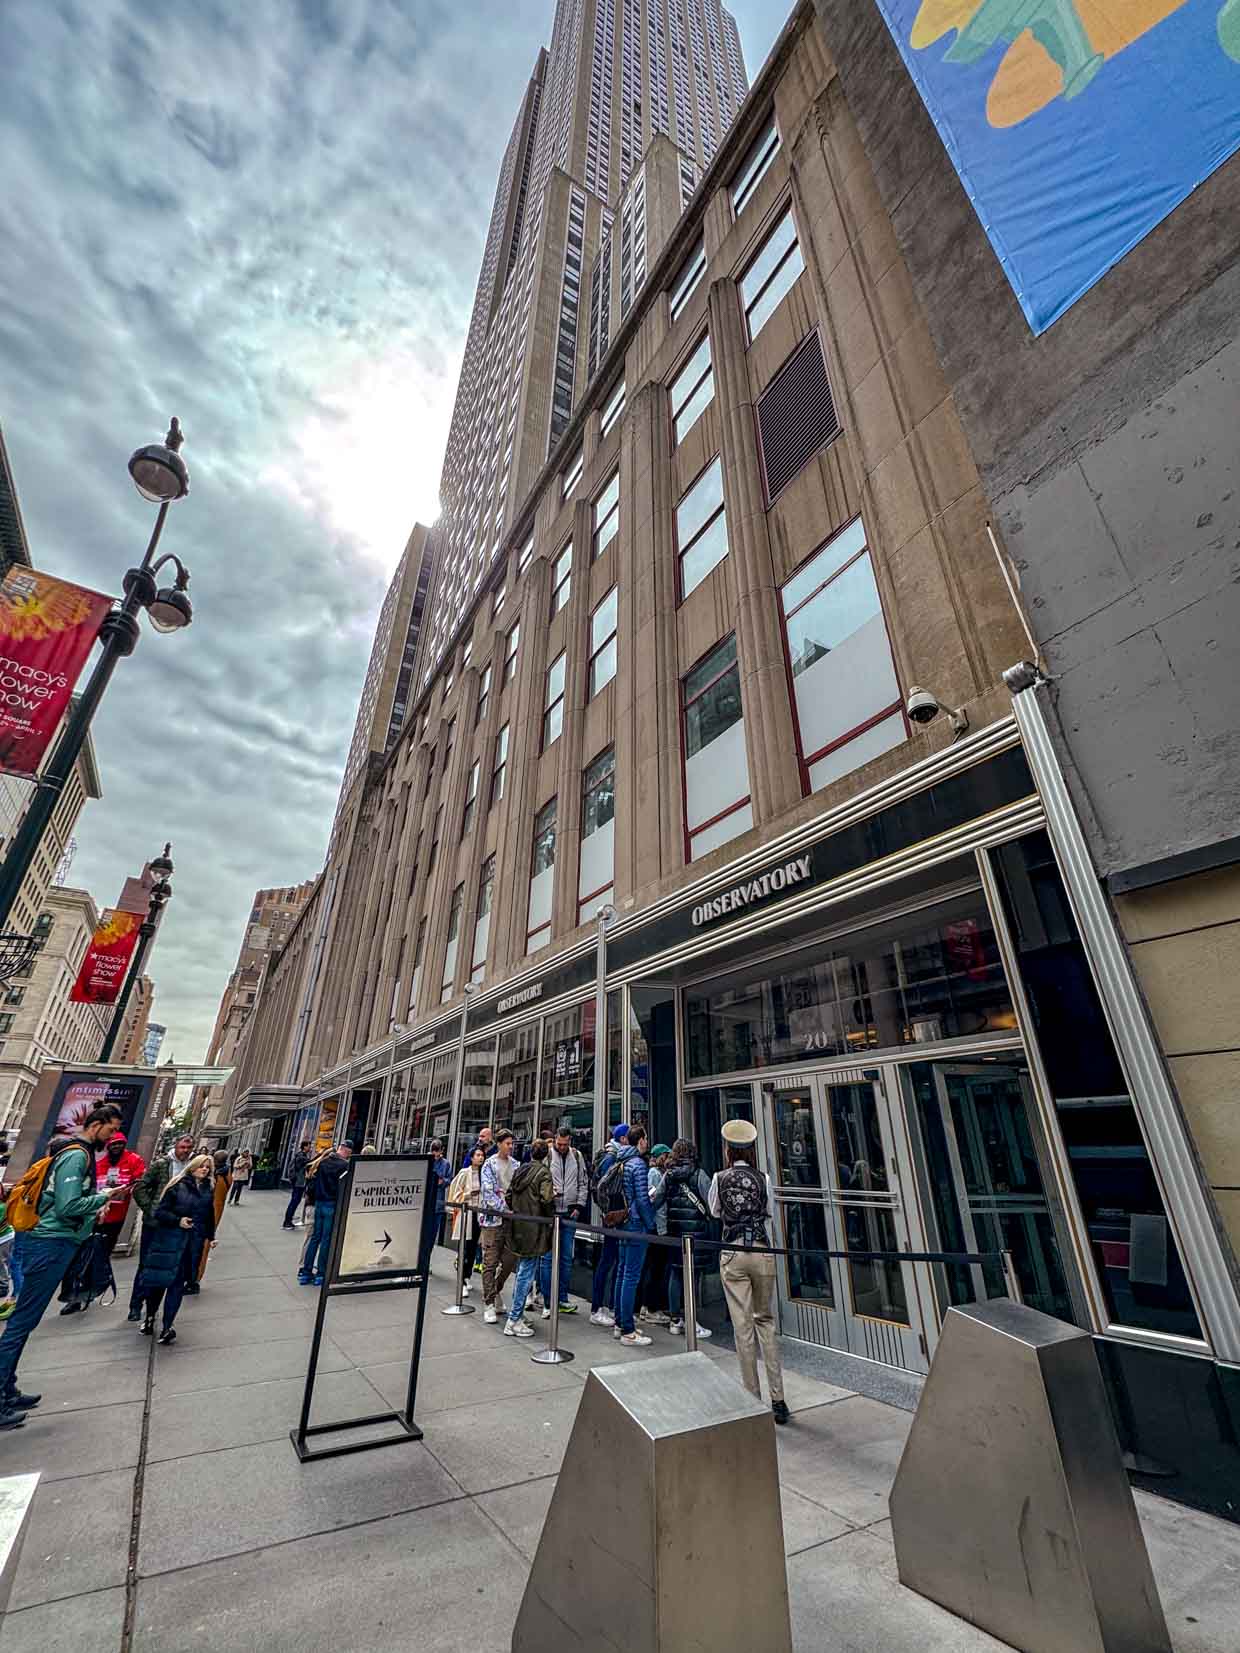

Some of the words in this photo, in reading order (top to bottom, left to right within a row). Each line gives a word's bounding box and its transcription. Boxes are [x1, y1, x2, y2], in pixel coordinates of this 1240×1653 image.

[691, 854, 811, 927] OBSERVATORY
[803, 1031, 828, 1050] 20
[150, 1077, 169, 1119] Newsstand
[383, 1177, 398, 1185] THE
[354, 1186, 392, 1198] EMPIRE
[394, 1184, 422, 1195] STATE
[363, 1196, 413, 1208] BUILDING
